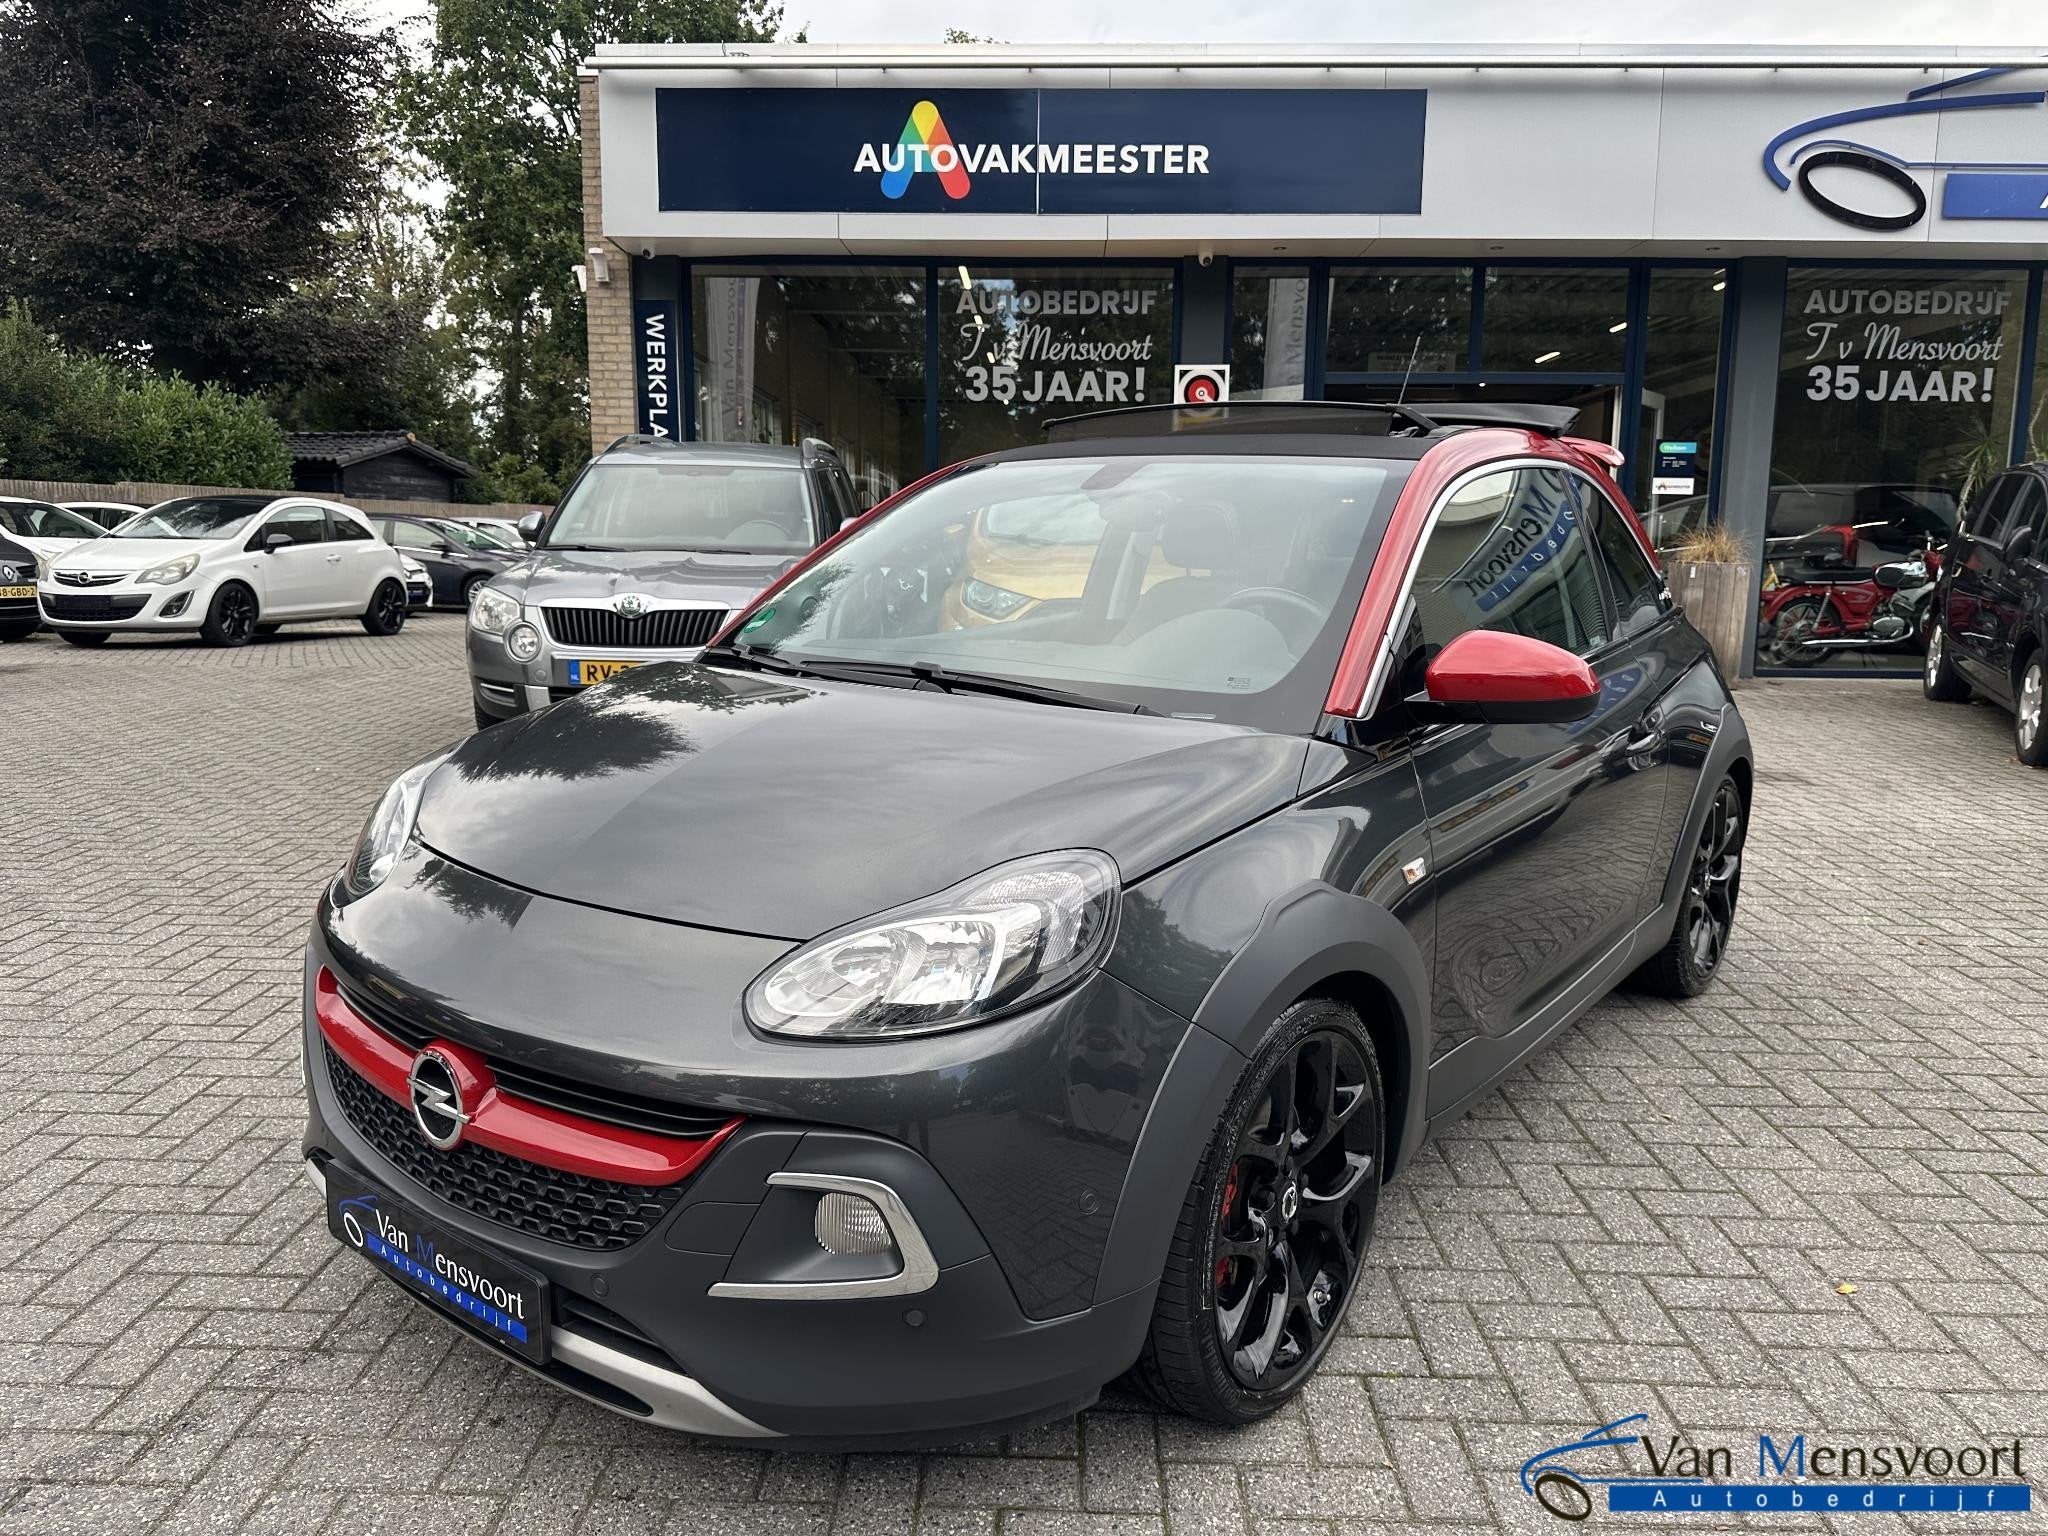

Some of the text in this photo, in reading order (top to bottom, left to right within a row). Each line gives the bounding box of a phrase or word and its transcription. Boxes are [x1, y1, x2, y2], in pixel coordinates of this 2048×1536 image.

[853, 143, 1211, 174] AUTOVAKMEESTER
[956, 290, 1158, 315] AUTOBEDRIJF
[1803, 289, 2012, 315] AUTOBEDRIJF
[1017, 322, 1153, 361] Mensvoort
[1863, 322, 2004, 361] Mensvoort
[965, 366, 1146, 402] 35 JAAR!
[1806, 365, 1995, 402] 35 JAAR!
[376, 1209, 525, 1320] Van Mensvoort
[380, 1244, 512, 1332] Autobedrijf
